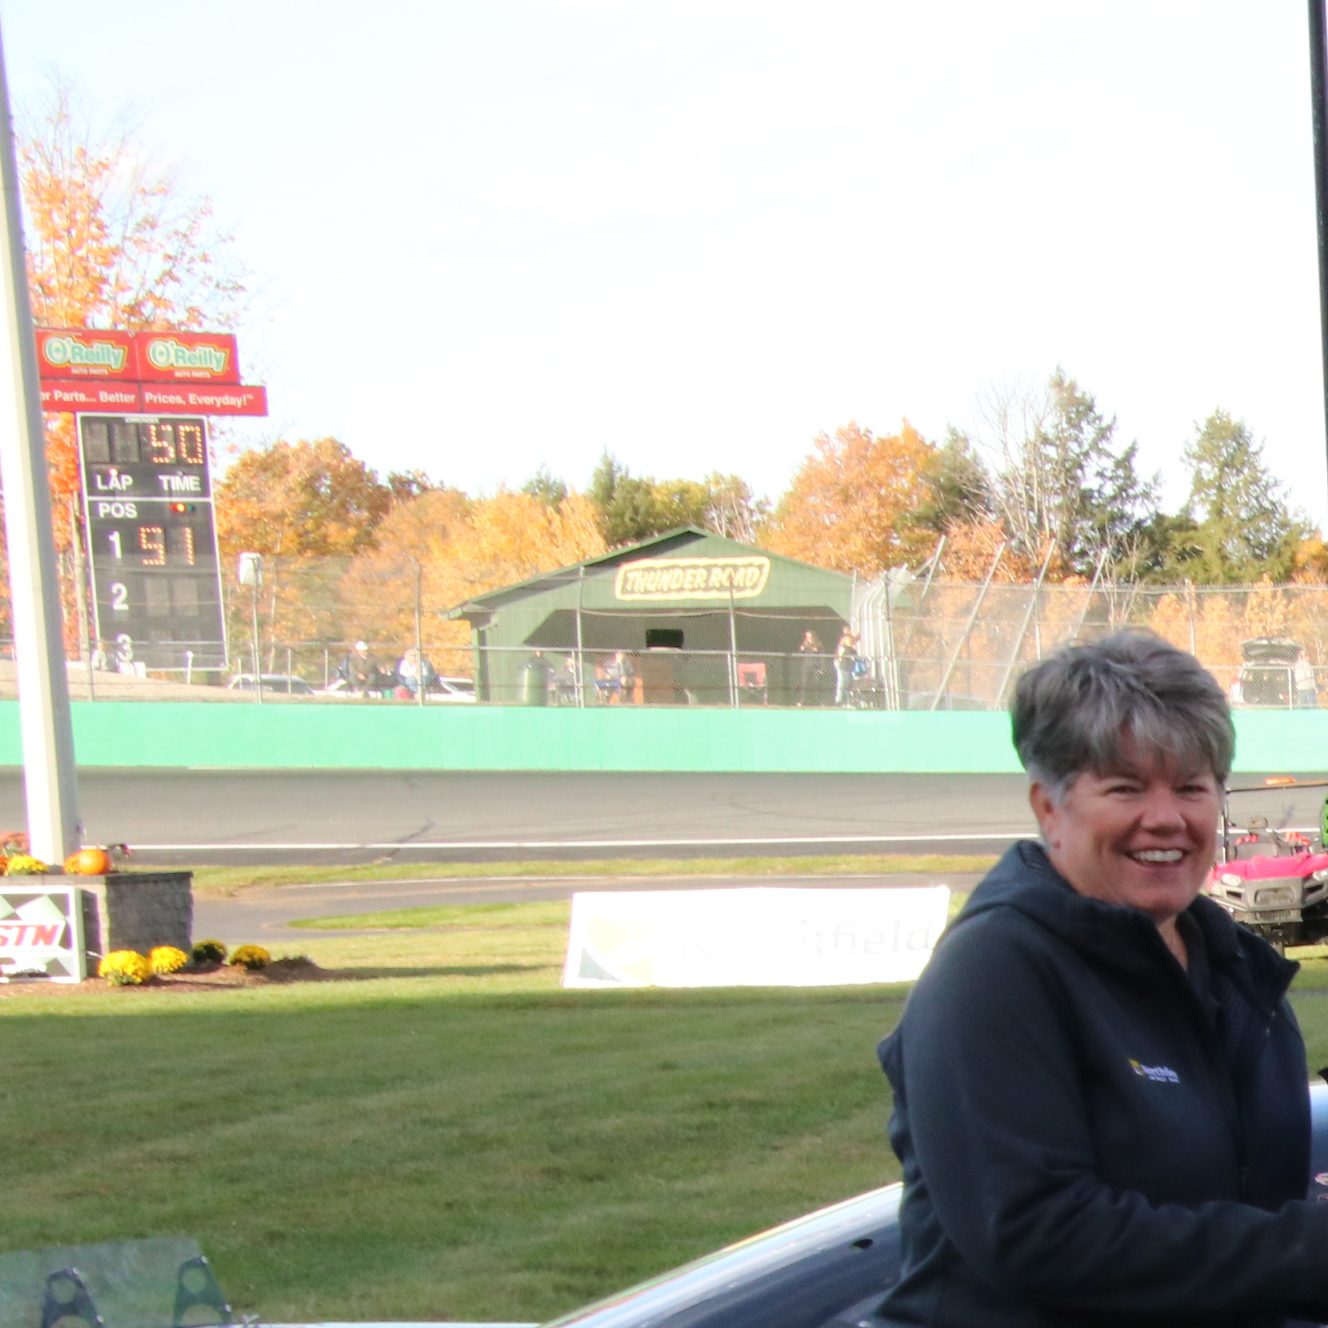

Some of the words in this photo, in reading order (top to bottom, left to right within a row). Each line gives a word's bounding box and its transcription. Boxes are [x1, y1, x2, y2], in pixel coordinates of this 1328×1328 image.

[45, 336, 125, 370] O'Reilly
[149, 338, 227, 372] O'Reilly
[100, 392, 137, 404] Better
[144, 392, 186, 406] Prices,
[149, 424, 204, 464] 50
[96, 474, 134, 491] LAP
[158, 475, 202, 491] TIME
[99, 502, 138, 519] POS
[109, 530, 123, 559] 1
[625, 567, 709, 593] THUNDER
[708, 566, 761, 588] ROAD
[111, 582, 130, 611] 2
